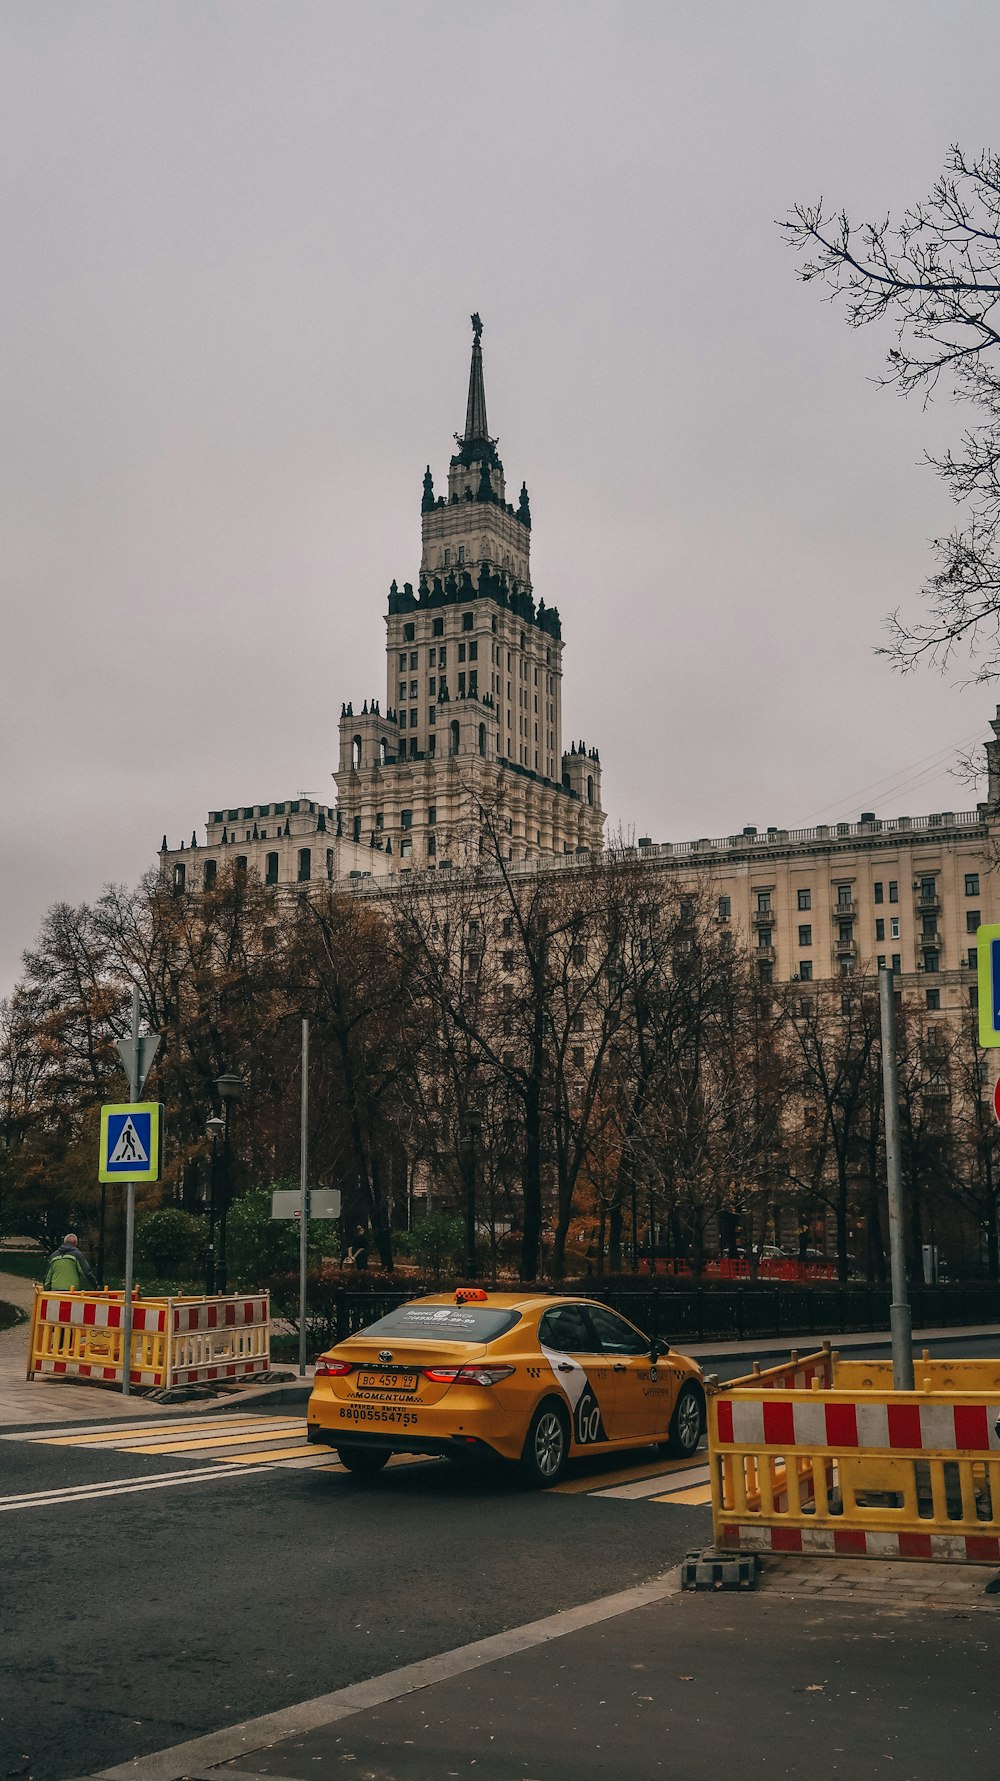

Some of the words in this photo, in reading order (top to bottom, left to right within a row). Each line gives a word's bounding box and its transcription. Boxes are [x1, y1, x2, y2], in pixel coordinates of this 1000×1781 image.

[379, 1374, 398, 1386] 459
[403, 1375, 413, 1384] 99
[354, 1392, 414, 1402] MOMENTUM
[340, 1408, 418, 1424] 88005554755
[579, 1394, 600, 1443] Go
